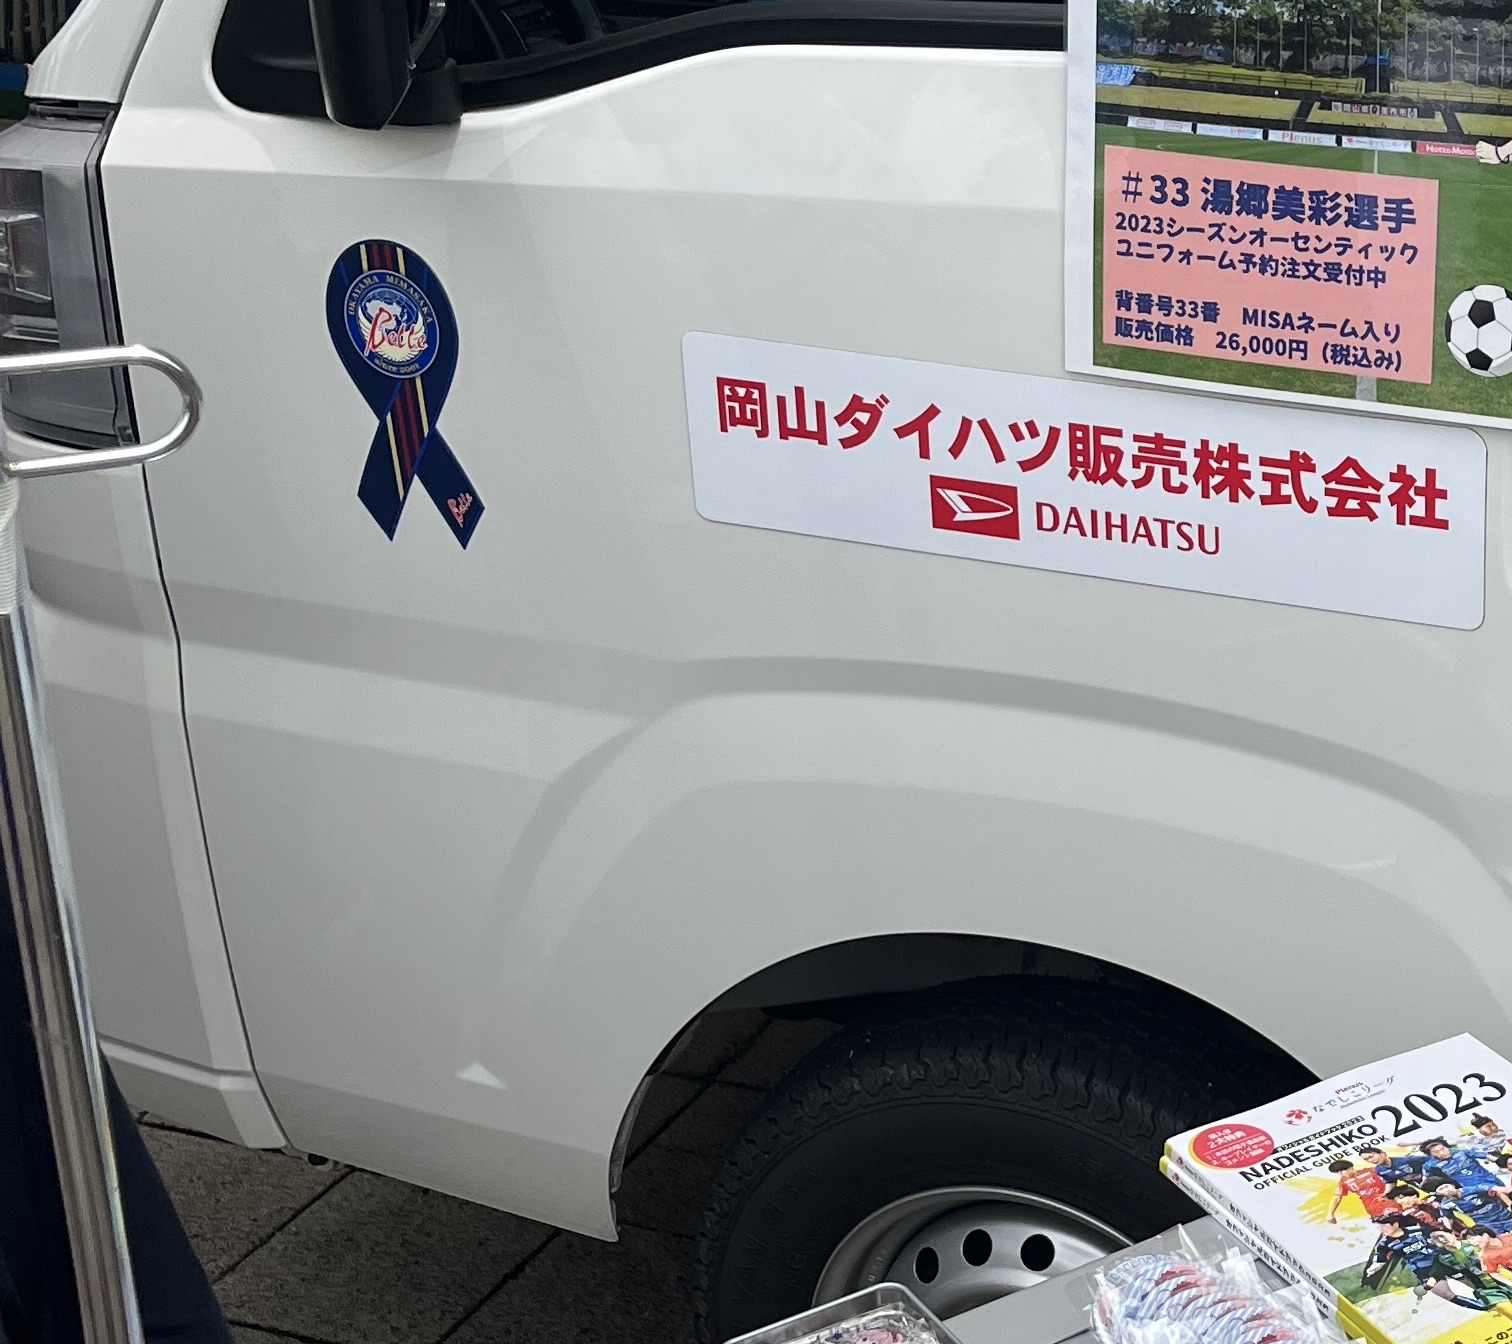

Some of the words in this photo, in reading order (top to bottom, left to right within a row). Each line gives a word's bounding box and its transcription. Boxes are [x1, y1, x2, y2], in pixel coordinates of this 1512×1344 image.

[1281, 131, 1323, 145] Plenus
[1200, 176, 1418, 235] 湯郷美彩選手
[1114, 212, 1419, 265] 2023シーズンオーセンティック
[1116, 239, 1387, 289] ユニフォーム予約注文受付中
[364, 306, 428, 356] Belle
[1114, 289, 1221, 324] 背番号33番
[1242, 307, 1401, 344] MISAネーム入り
[1114, 316, 1195, 348] 販売価格
[716, 376, 1450, 532] 岡山ダイハツ販売株式会社
[1036, 501, 1222, 556] DAIHATSU
[1313, 1075, 1396, 1112] なでしこリーグ
[1239, 1123, 1379, 1182] NADESHIKO
[1372, 1072, 1507, 1138] 2023
[1253, 1164, 1310, 1191] OFFICIAL
[1312, 1150, 1353, 1169] GUIDE
